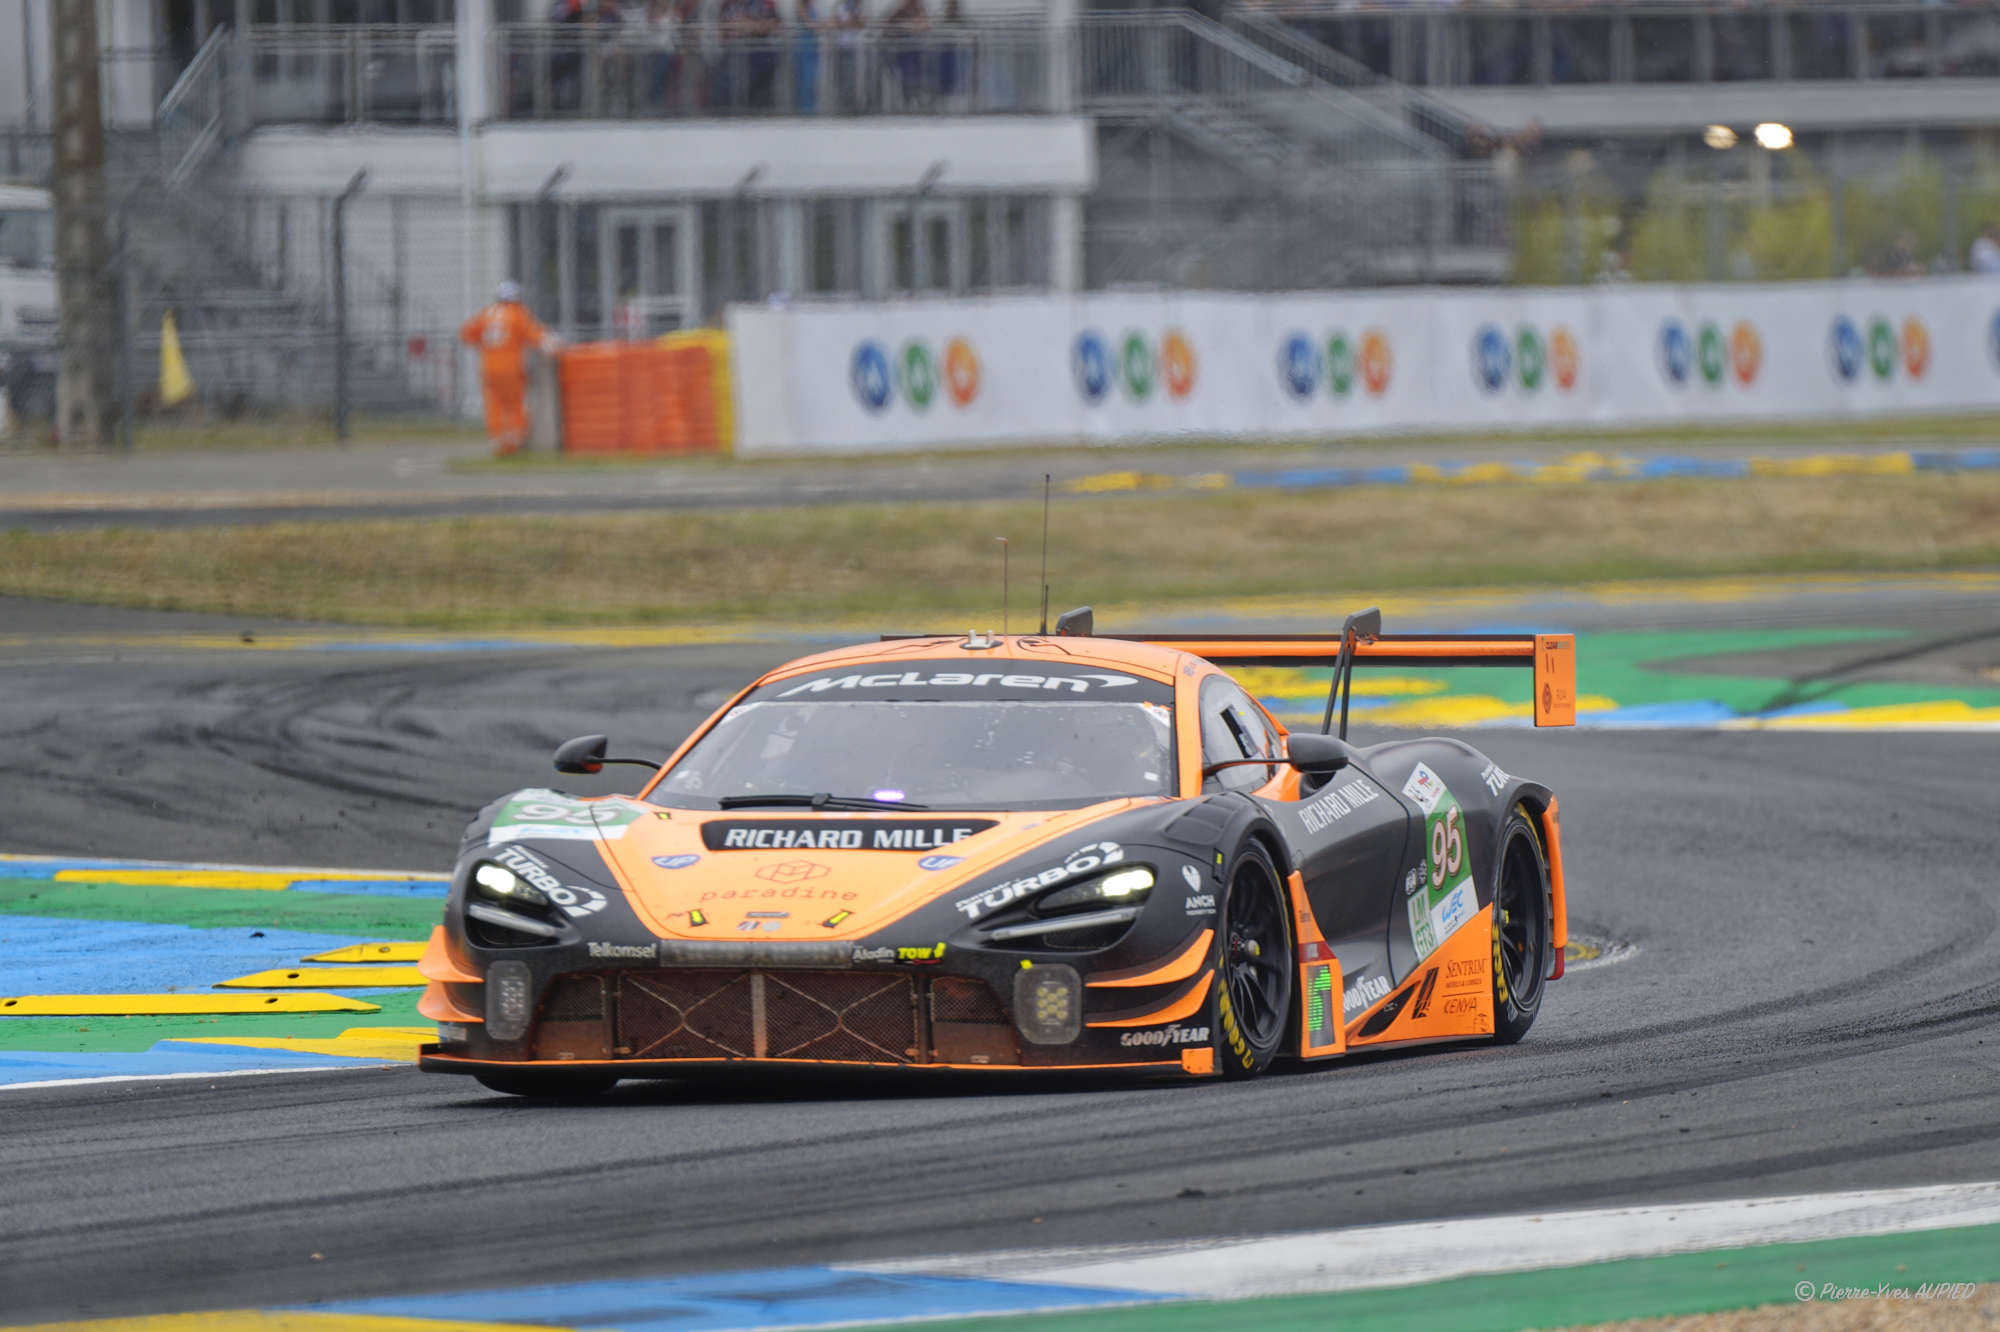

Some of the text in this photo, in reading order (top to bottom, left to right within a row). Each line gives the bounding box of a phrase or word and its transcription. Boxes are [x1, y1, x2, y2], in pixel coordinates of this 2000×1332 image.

[777, 672, 1097, 698] McLaren
[512, 803, 620, 824] 95
[1298, 793, 1351, 834] RICHARD
[1338, 780, 1379, 808] MILLE
[724, 829, 972, 849] RICHARD MILLE
[1431, 804, 1462, 890] 95
[494, 847, 577, 908] TURBO
[958, 855, 1101, 919] TURBO
[701, 886, 858, 902] paradine
[587, 942, 657, 957] Telkomsel
[898, 946, 932, 959] TOW
[1343, 976, 1392, 1012] OODYEAR
[1120, 1024, 1210, 1046] GOODYEAR
